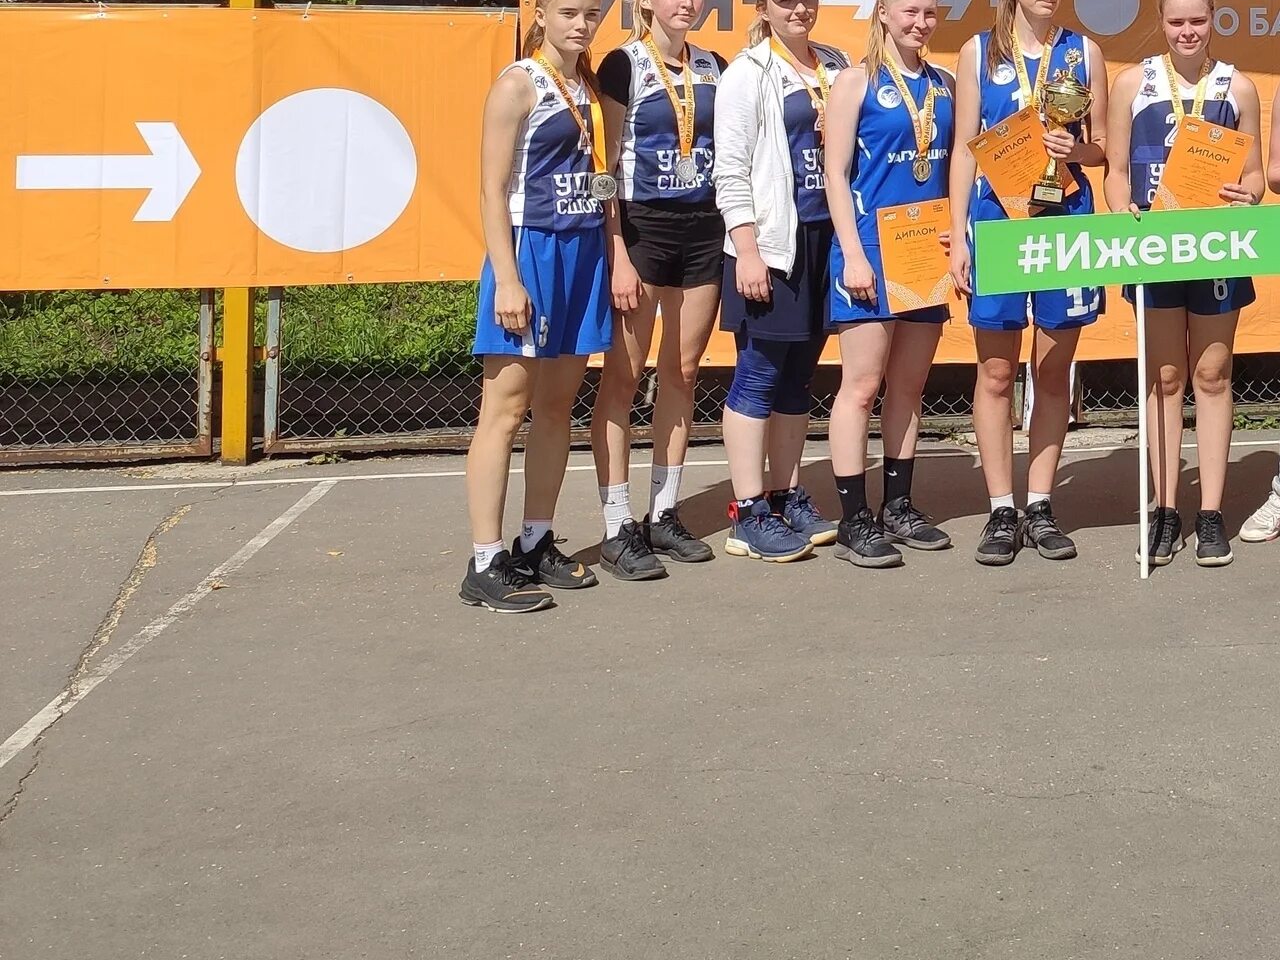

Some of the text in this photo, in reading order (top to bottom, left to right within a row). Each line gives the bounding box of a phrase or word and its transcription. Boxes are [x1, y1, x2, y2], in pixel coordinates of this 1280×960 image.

[993, 133, 1032, 162] ДИПЛОМ
[1187, 145, 1230, 164] ДИПЛОМ
[895, 227, 936, 241] ДИПЛОМ
[1017, 229, 1259, 274] #Ижевск
